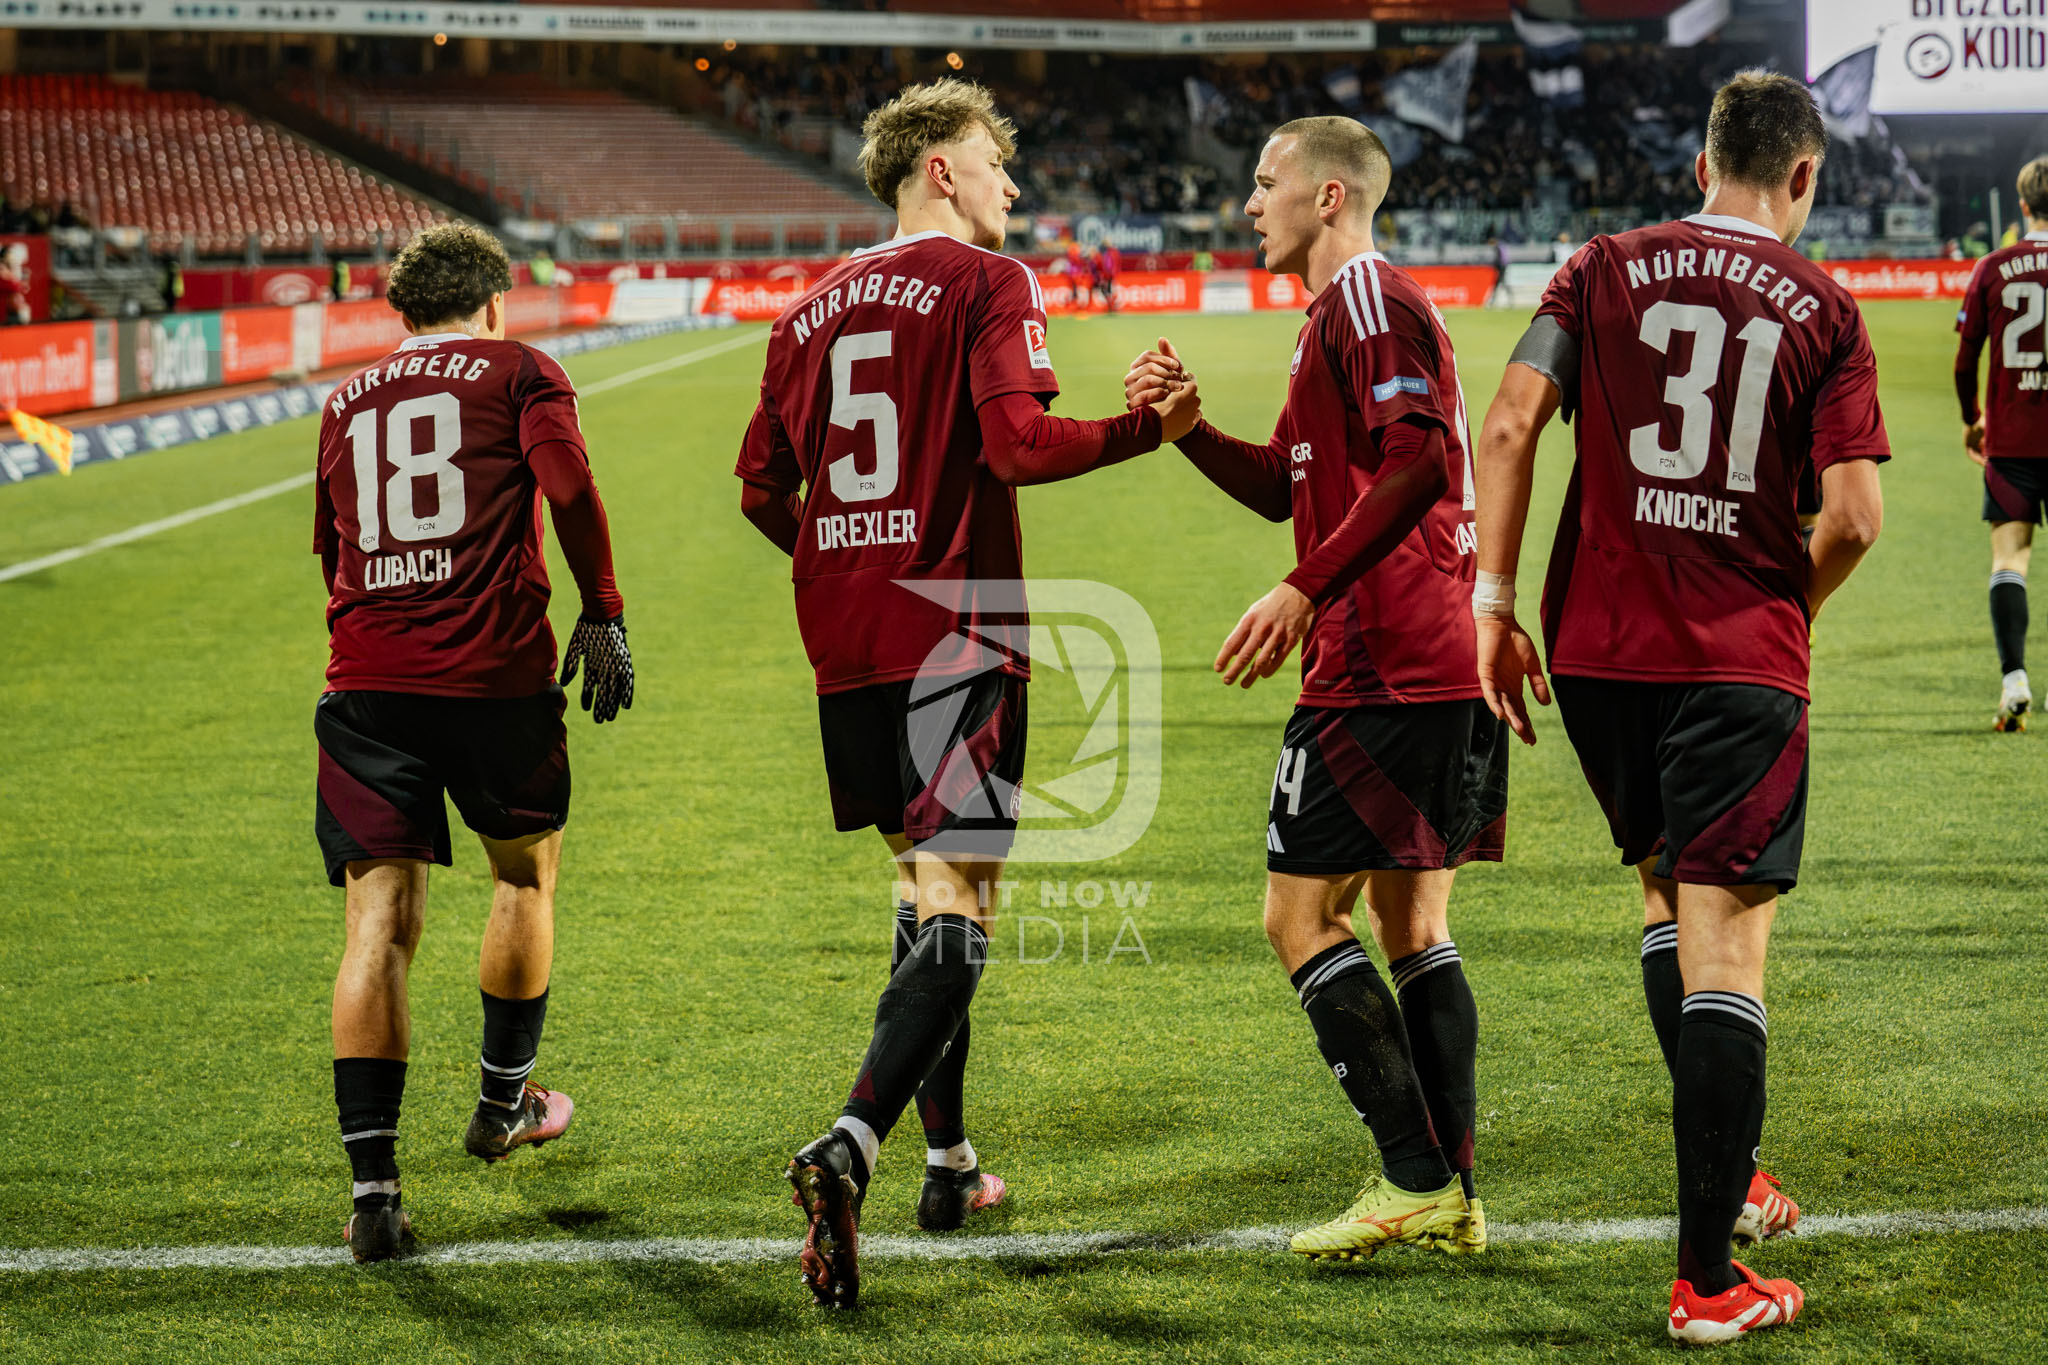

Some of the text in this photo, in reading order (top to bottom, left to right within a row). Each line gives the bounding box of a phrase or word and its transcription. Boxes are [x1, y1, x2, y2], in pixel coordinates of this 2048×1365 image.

[1713, 232, 1757, 246] DER CLUB
[792, 273, 942, 345] NÜRNBERG
[1626, 247, 1821, 323] NÜRNBERG
[2001, 281, 2048, 369] 2
[330, 352, 491, 419] NÜRNBERG
[1629, 300, 1785, 494] 31
[828, 330, 899, 503] 5
[344, 391, 467, 554] 18
[859, 481, 876, 491] FCN
[1659, 457, 1676, 469] FCN
[1731, 471, 1752, 483] FCN
[416, 521, 436, 533] FCN
[816, 508, 917, 551] DREXLER
[1635, 486, 1741, 538] KNOCHE
[361, 534, 377, 546] FCN
[364, 547, 453, 592] LUBACH
